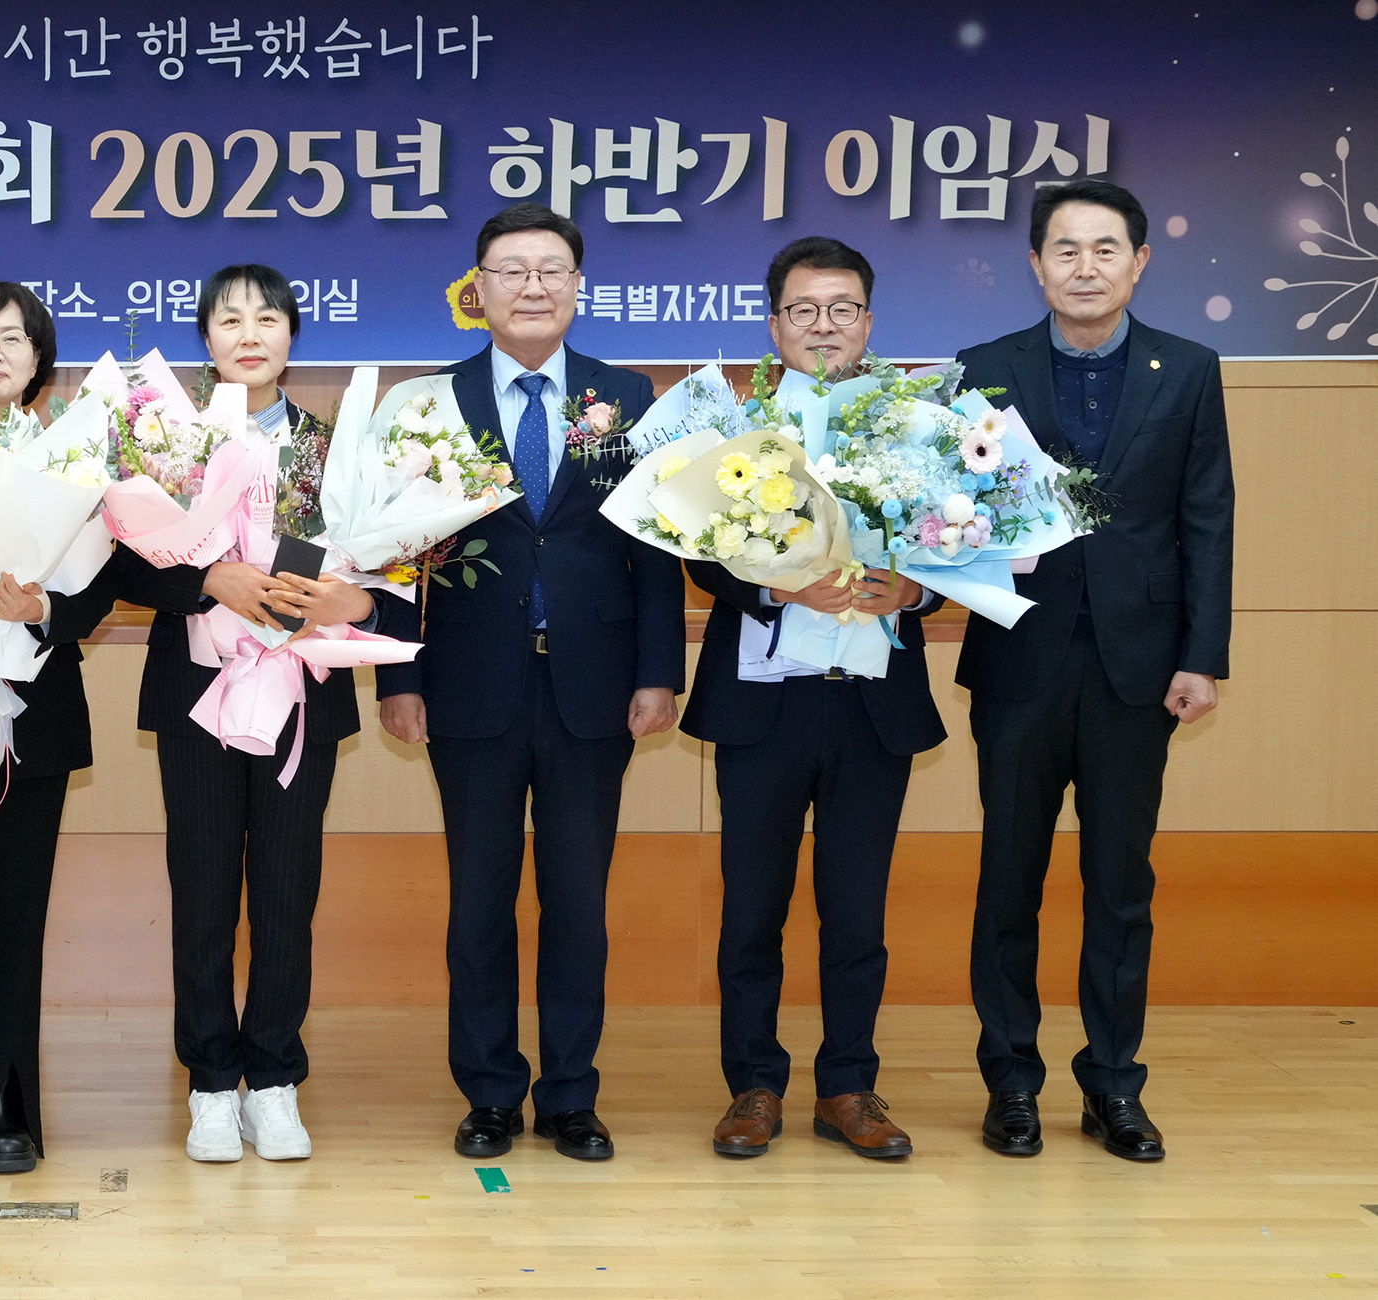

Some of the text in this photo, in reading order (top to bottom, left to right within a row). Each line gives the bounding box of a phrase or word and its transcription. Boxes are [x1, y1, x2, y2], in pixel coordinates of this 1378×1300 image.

[3, 17, 121, 82] 시간
[136, 14, 494, 80] 행복했습니다
[91, 118, 448, 220] 2025년
[488, 116, 788, 223] 하반기
